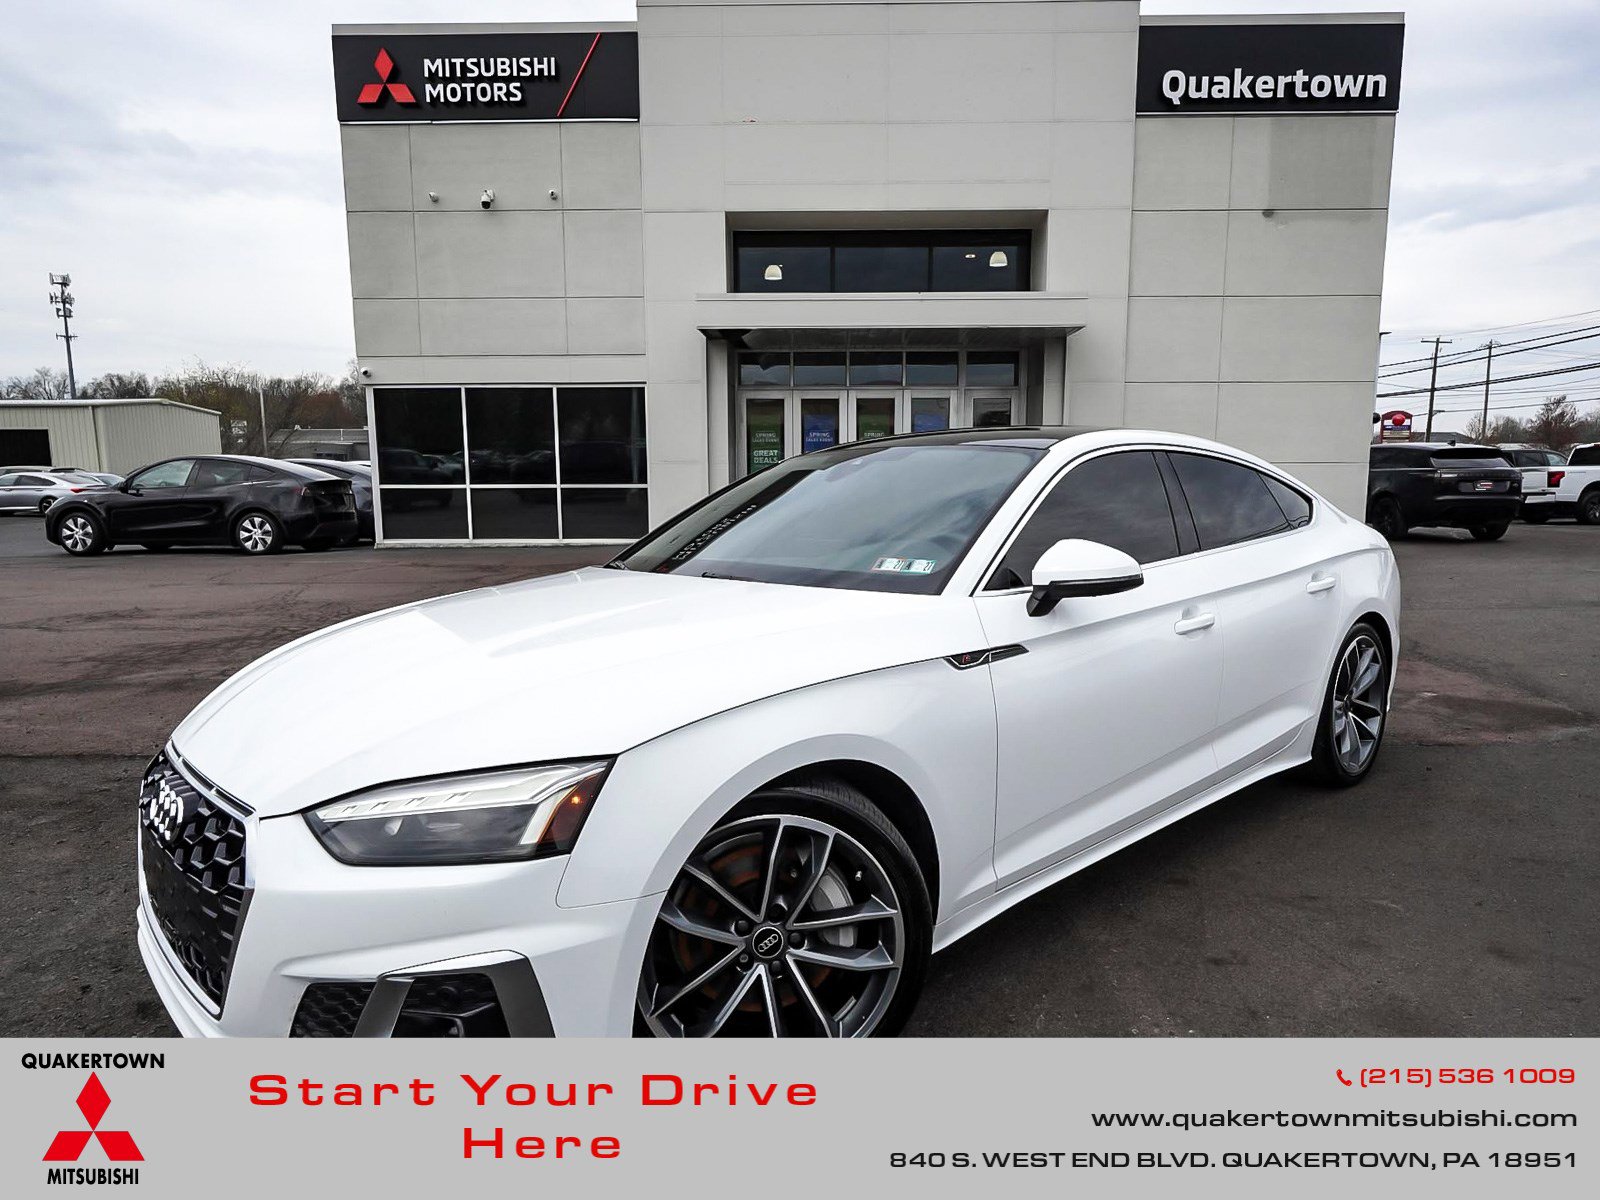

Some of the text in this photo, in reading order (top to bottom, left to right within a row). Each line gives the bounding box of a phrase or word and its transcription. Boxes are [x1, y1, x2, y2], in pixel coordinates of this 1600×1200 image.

[423, 57, 556, 78] MITSUBISHI
[424, 82, 522, 103] MOTORS
[1162, 68, 1387, 105] Quakertown
[753, 449, 779, 457] GREAT
